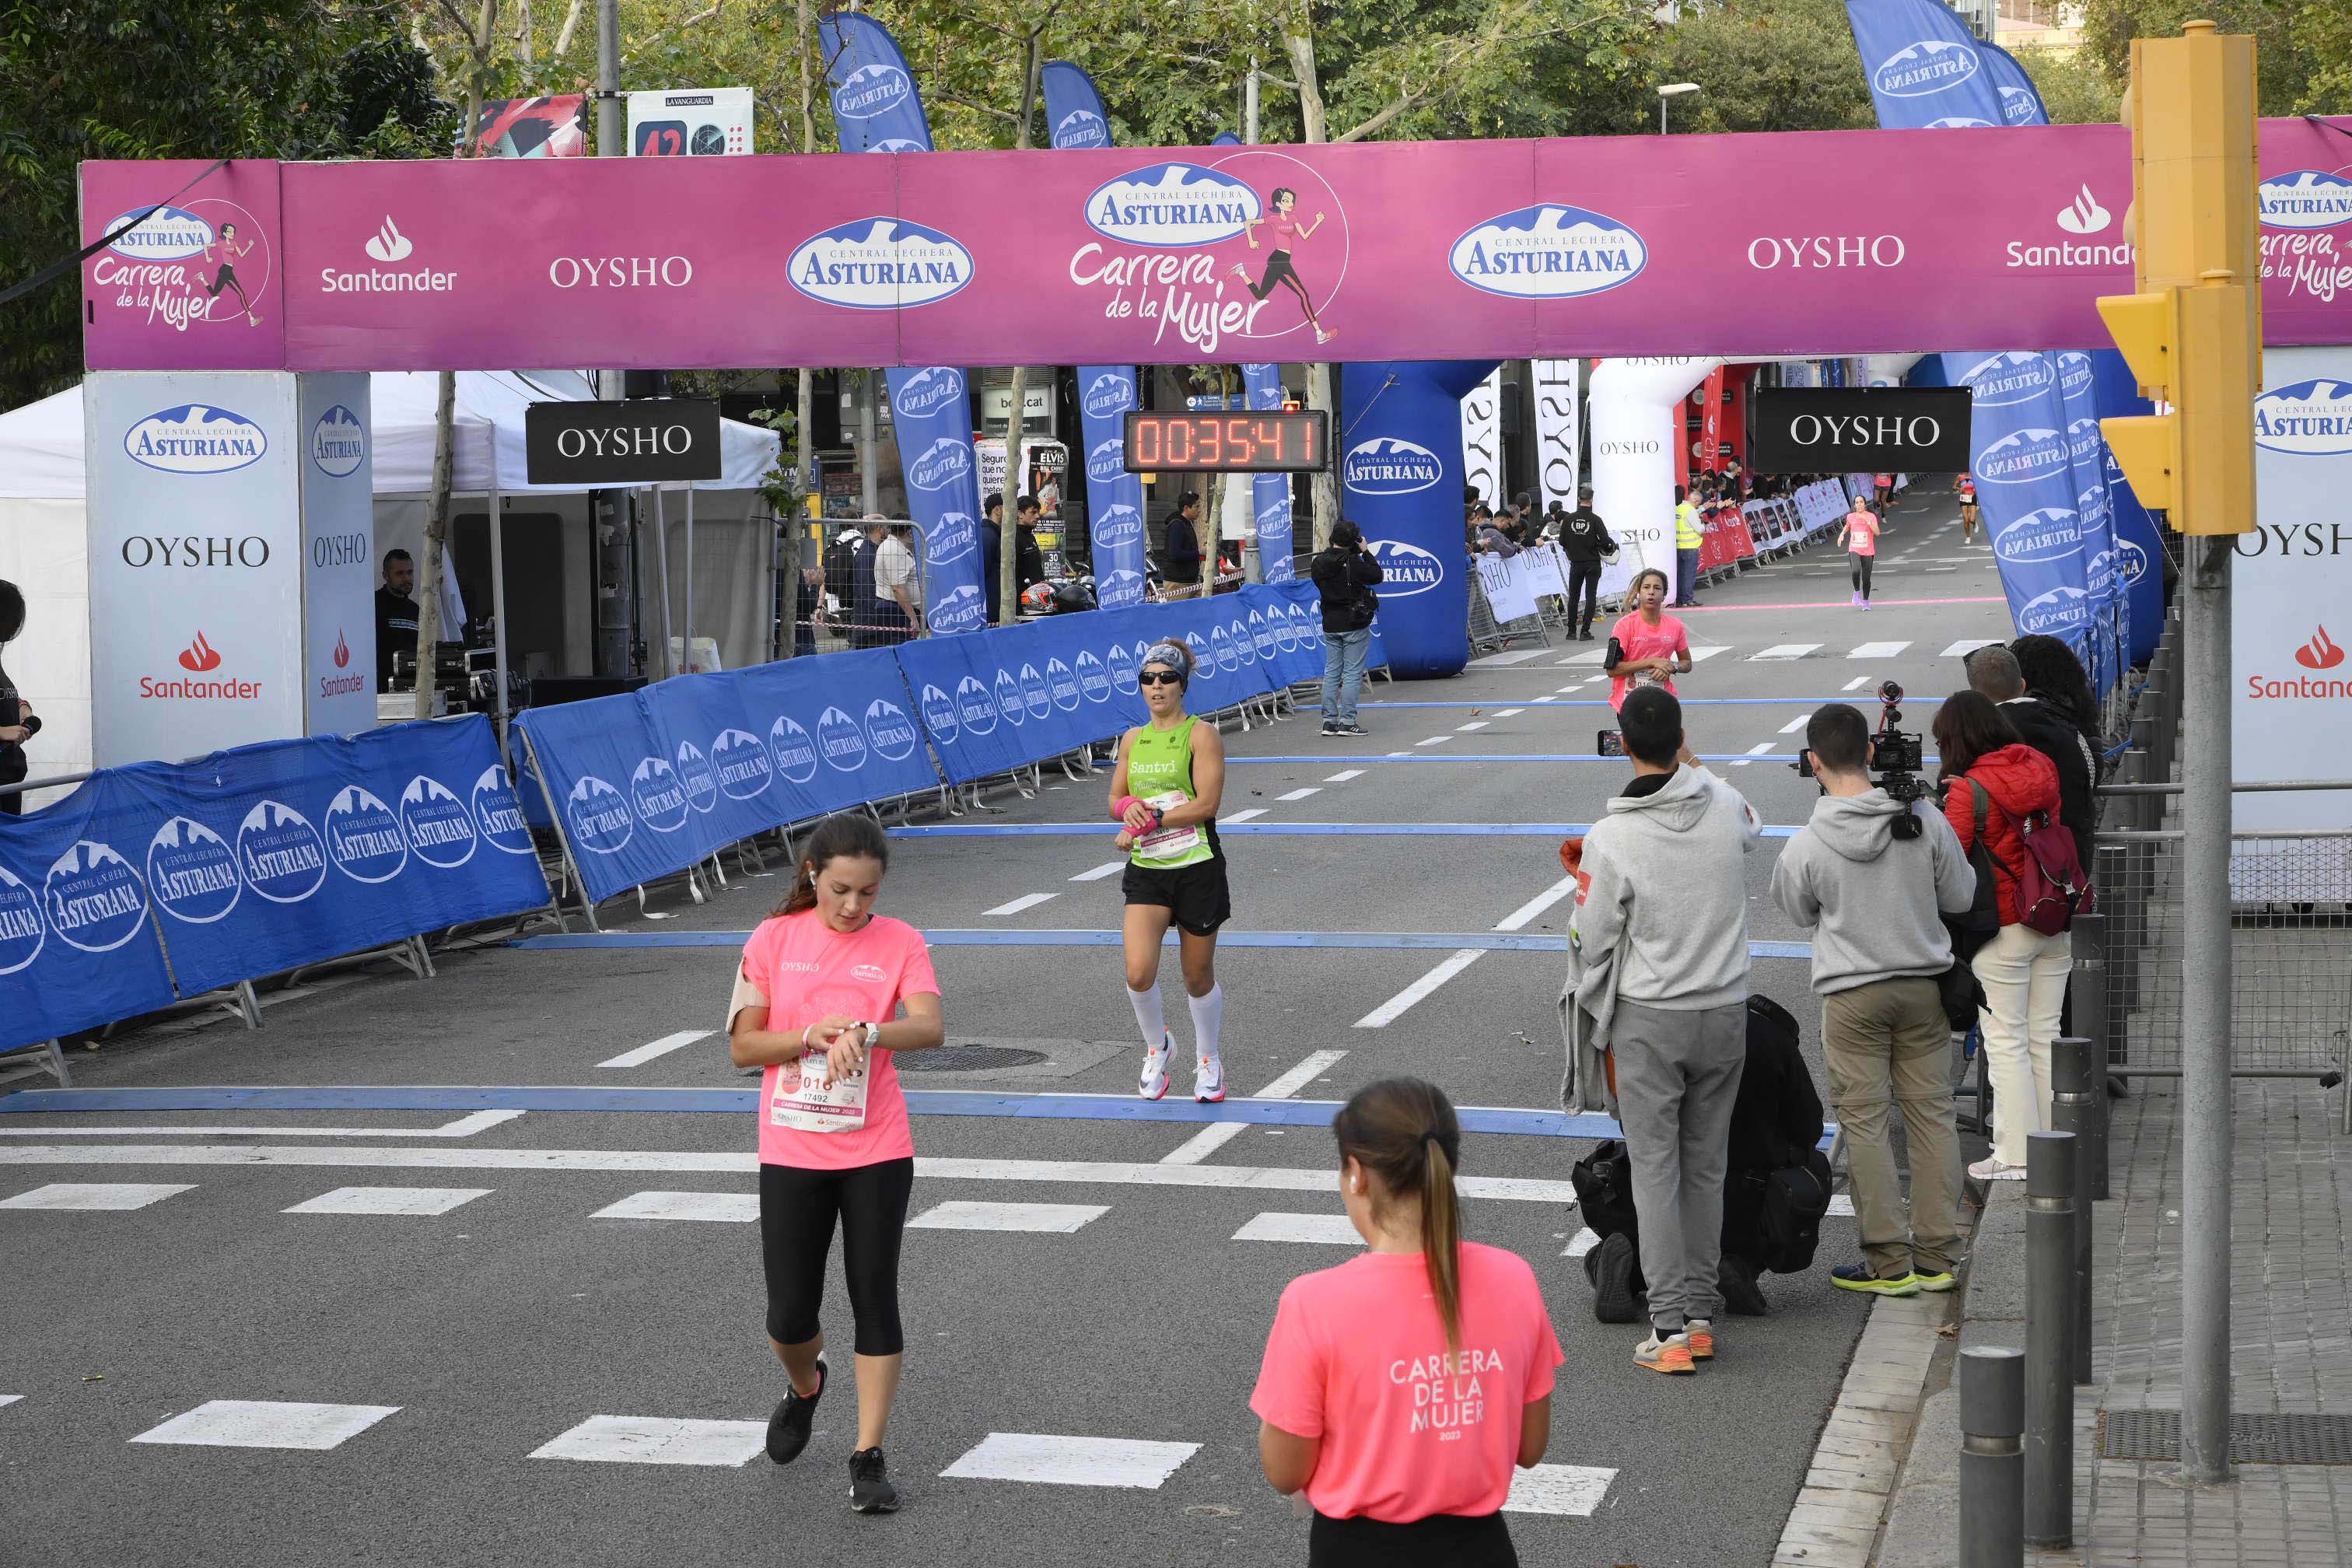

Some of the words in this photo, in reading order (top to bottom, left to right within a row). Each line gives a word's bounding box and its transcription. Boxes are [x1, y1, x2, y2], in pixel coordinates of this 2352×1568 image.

[1125, 192, 1180, 201] CENTRAL
[1186, 191, 1243, 199] LECHERA
[1098, 194, 1246, 226] ASTURIANA
[830, 249, 888, 258] CENTRAL
[894, 248, 953, 257] LECHERA
[1495, 236, 1556, 247] CENTRAL
[1563, 234, 1626, 247] LECHERA
[1748, 234, 1906, 270] OYSHO
[2259, 233, 2333, 256] arrera
[801, 252, 960, 285] ASTURIANA
[1069, 243, 1215, 286] Carrera
[1465, 240, 1632, 275] ASTURIANA
[2277, 256, 2292, 278] la
[94, 257, 184, 285] Carrera
[321, 267, 457, 292] Santander
[549, 255, 692, 289] OYSHO
[117, 288, 134, 306] de
[137, 285, 149, 306] la
[148, 283, 220, 331] Mujer
[1105, 289, 1132, 318] de
[1138, 287, 1157, 318] la
[1153, 280, 1270, 354] Mujer
[135, 429, 257, 457] ASTURIANA
[557, 425, 692, 458] OYSHO
[1790, 414, 1940, 447] OYSHO
[316, 432, 362, 460] ASTURIANA
[1040, 453, 1064, 464] ELVIS
[1600, 440, 1659, 456] OYSHO
[982, 476, 1006, 487] quiere
[1346, 460, 1435, 482] ASTURIANA
[122, 536, 270, 568] OYSHO
[314, 533, 366, 569] OYSHO
[1048, 553, 1059, 562] 30
[140, 677, 262, 699] Santander
[320, 672, 365, 698] Santander
[775, 744, 815, 769] ASTURIANA
[821, 733, 865, 758] ASTURIANA
[715, 755, 772, 786] ASTURIANA
[413, 809, 436, 819] CENTRAL
[436, 804, 460, 816] LECHERA
[485, 796, 513, 806] CENTRAL
[340, 818, 366, 831] CENTRAL
[407, 813, 474, 849] ASTURIANA
[253, 836, 281, 849] CENTRAL
[282, 829, 311, 843] LECHERA
[333, 825, 405, 863] ASTURIANA
[165, 852, 194, 867] CENTRAL
[195, 847, 225, 861] LECHERA
[245, 843, 324, 882] ASTURIANA
[62, 880, 96, 894] CENTRAL
[156, 860, 238, 902] ASTURIANA
[781, 961, 820, 972] OYSHO
[803, 1094, 828, 1103] 17492
[1390, 1349, 1504, 1384] CARRERA
[1414, 1380, 1445, 1407] DE
[1453, 1375, 1482, 1400] LA
[1410, 1399, 1484, 1433] MUJER
[1440, 1430, 1461, 1441] 2023
